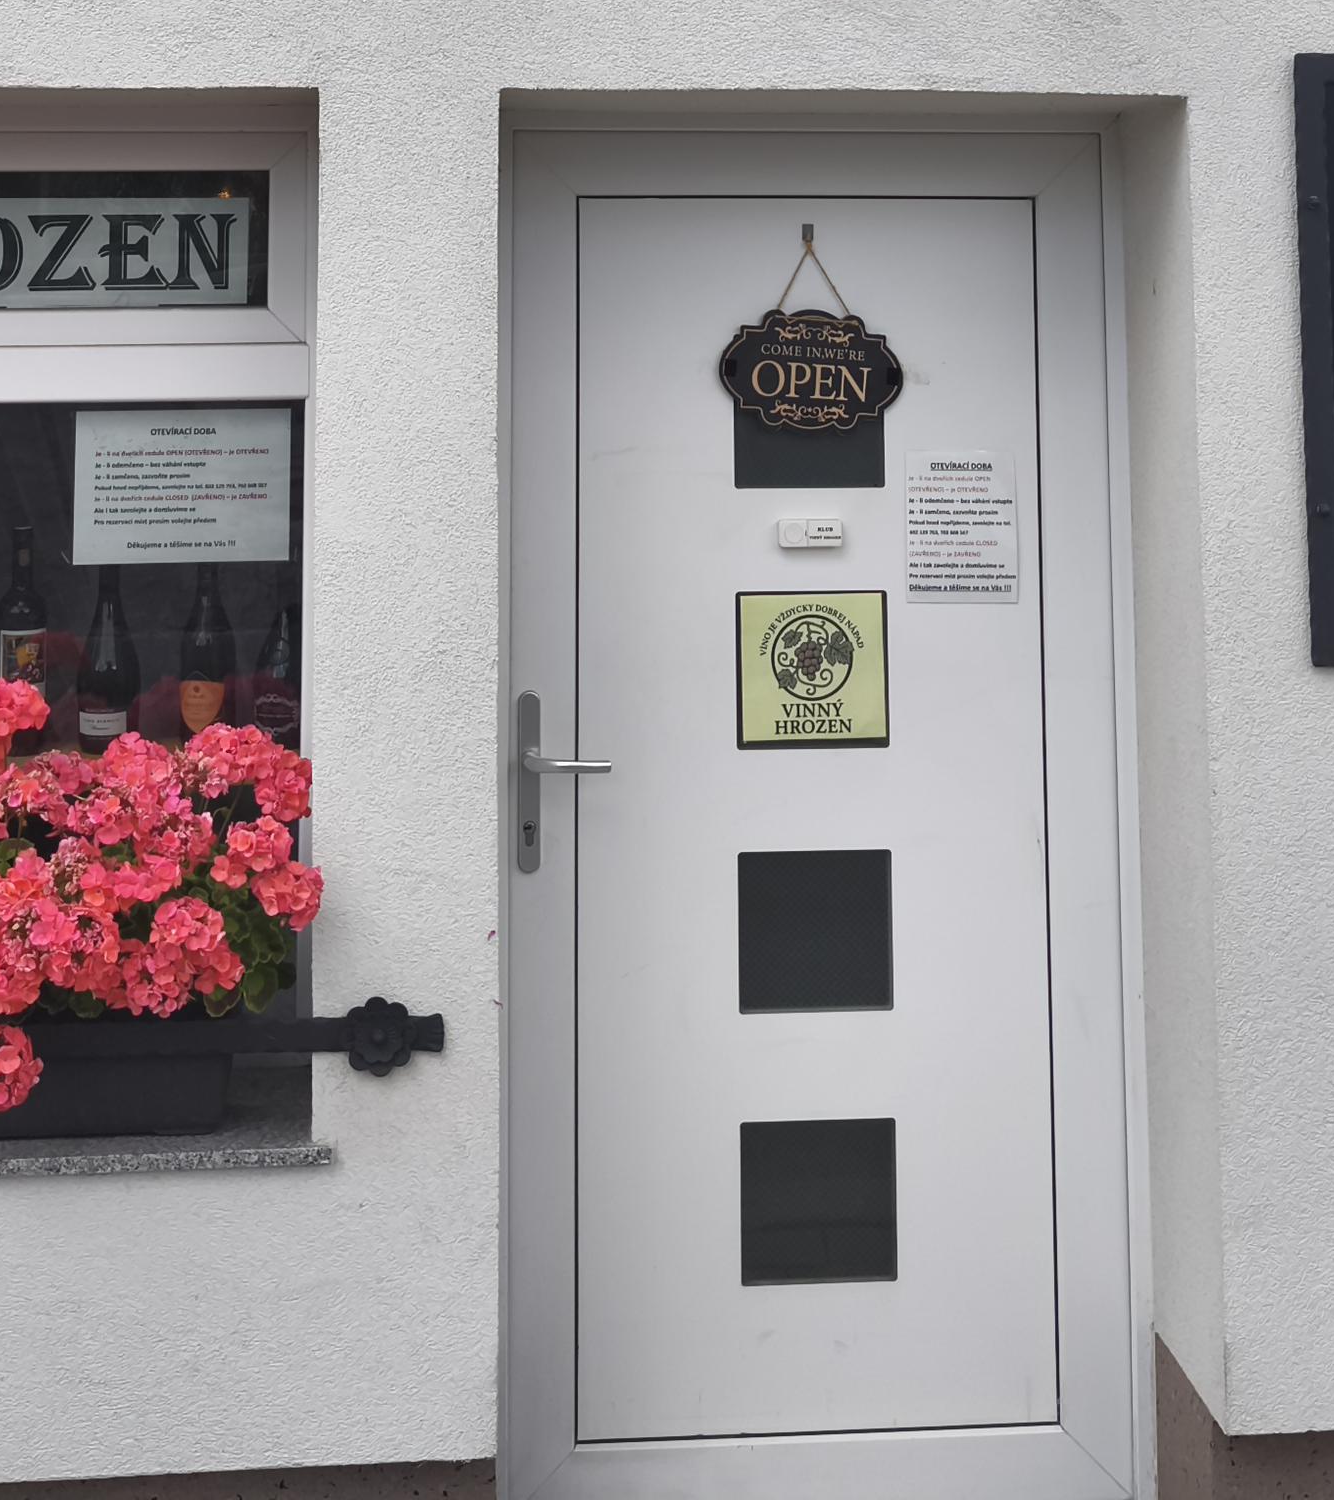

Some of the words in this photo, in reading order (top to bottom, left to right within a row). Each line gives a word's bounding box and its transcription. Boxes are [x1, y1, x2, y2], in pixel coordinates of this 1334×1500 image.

[761, 343, 802, 357] COME
[751, 360, 872, 403] OPEN
[151, 427, 192, 436] OTEVÍRACÍ
[194, 427, 216, 435] DOBA
[930, 461, 970, 470] OTEVÍRACÍ
[971, 462, 993, 470] DOBA
[759, 631, 772, 656] VÍNO
[768, 622, 778, 634] JE
[775, 604, 814, 624] VŽDYCKY
[815, 604, 846, 623] DOBREJ
[845, 620, 865, 649] NÁPAD
[781, 698, 844, 718] VINNÝ
[774, 718, 852, 735] HROZEN
